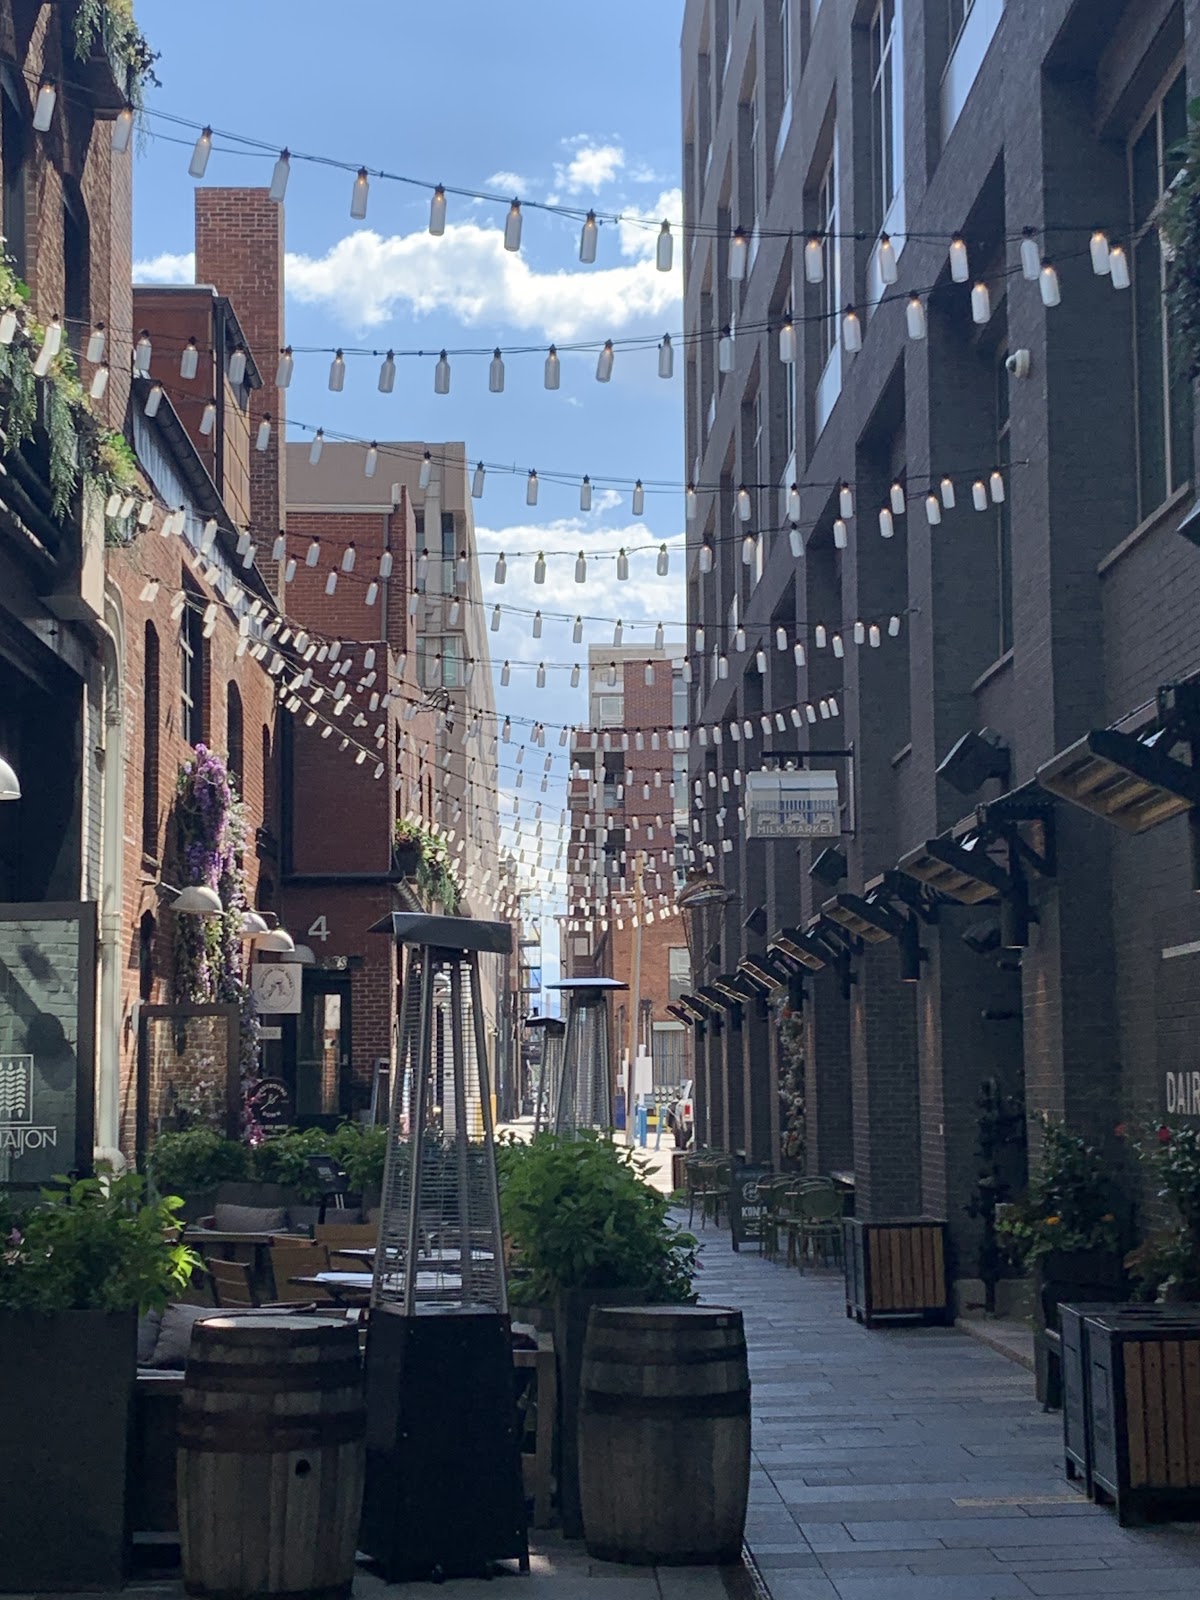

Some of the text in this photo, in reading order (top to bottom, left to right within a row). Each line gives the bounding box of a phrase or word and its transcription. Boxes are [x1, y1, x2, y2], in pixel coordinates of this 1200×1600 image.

[757, 824, 834, 834] MILK MARKET
[308, 915, 331, 941] 4
